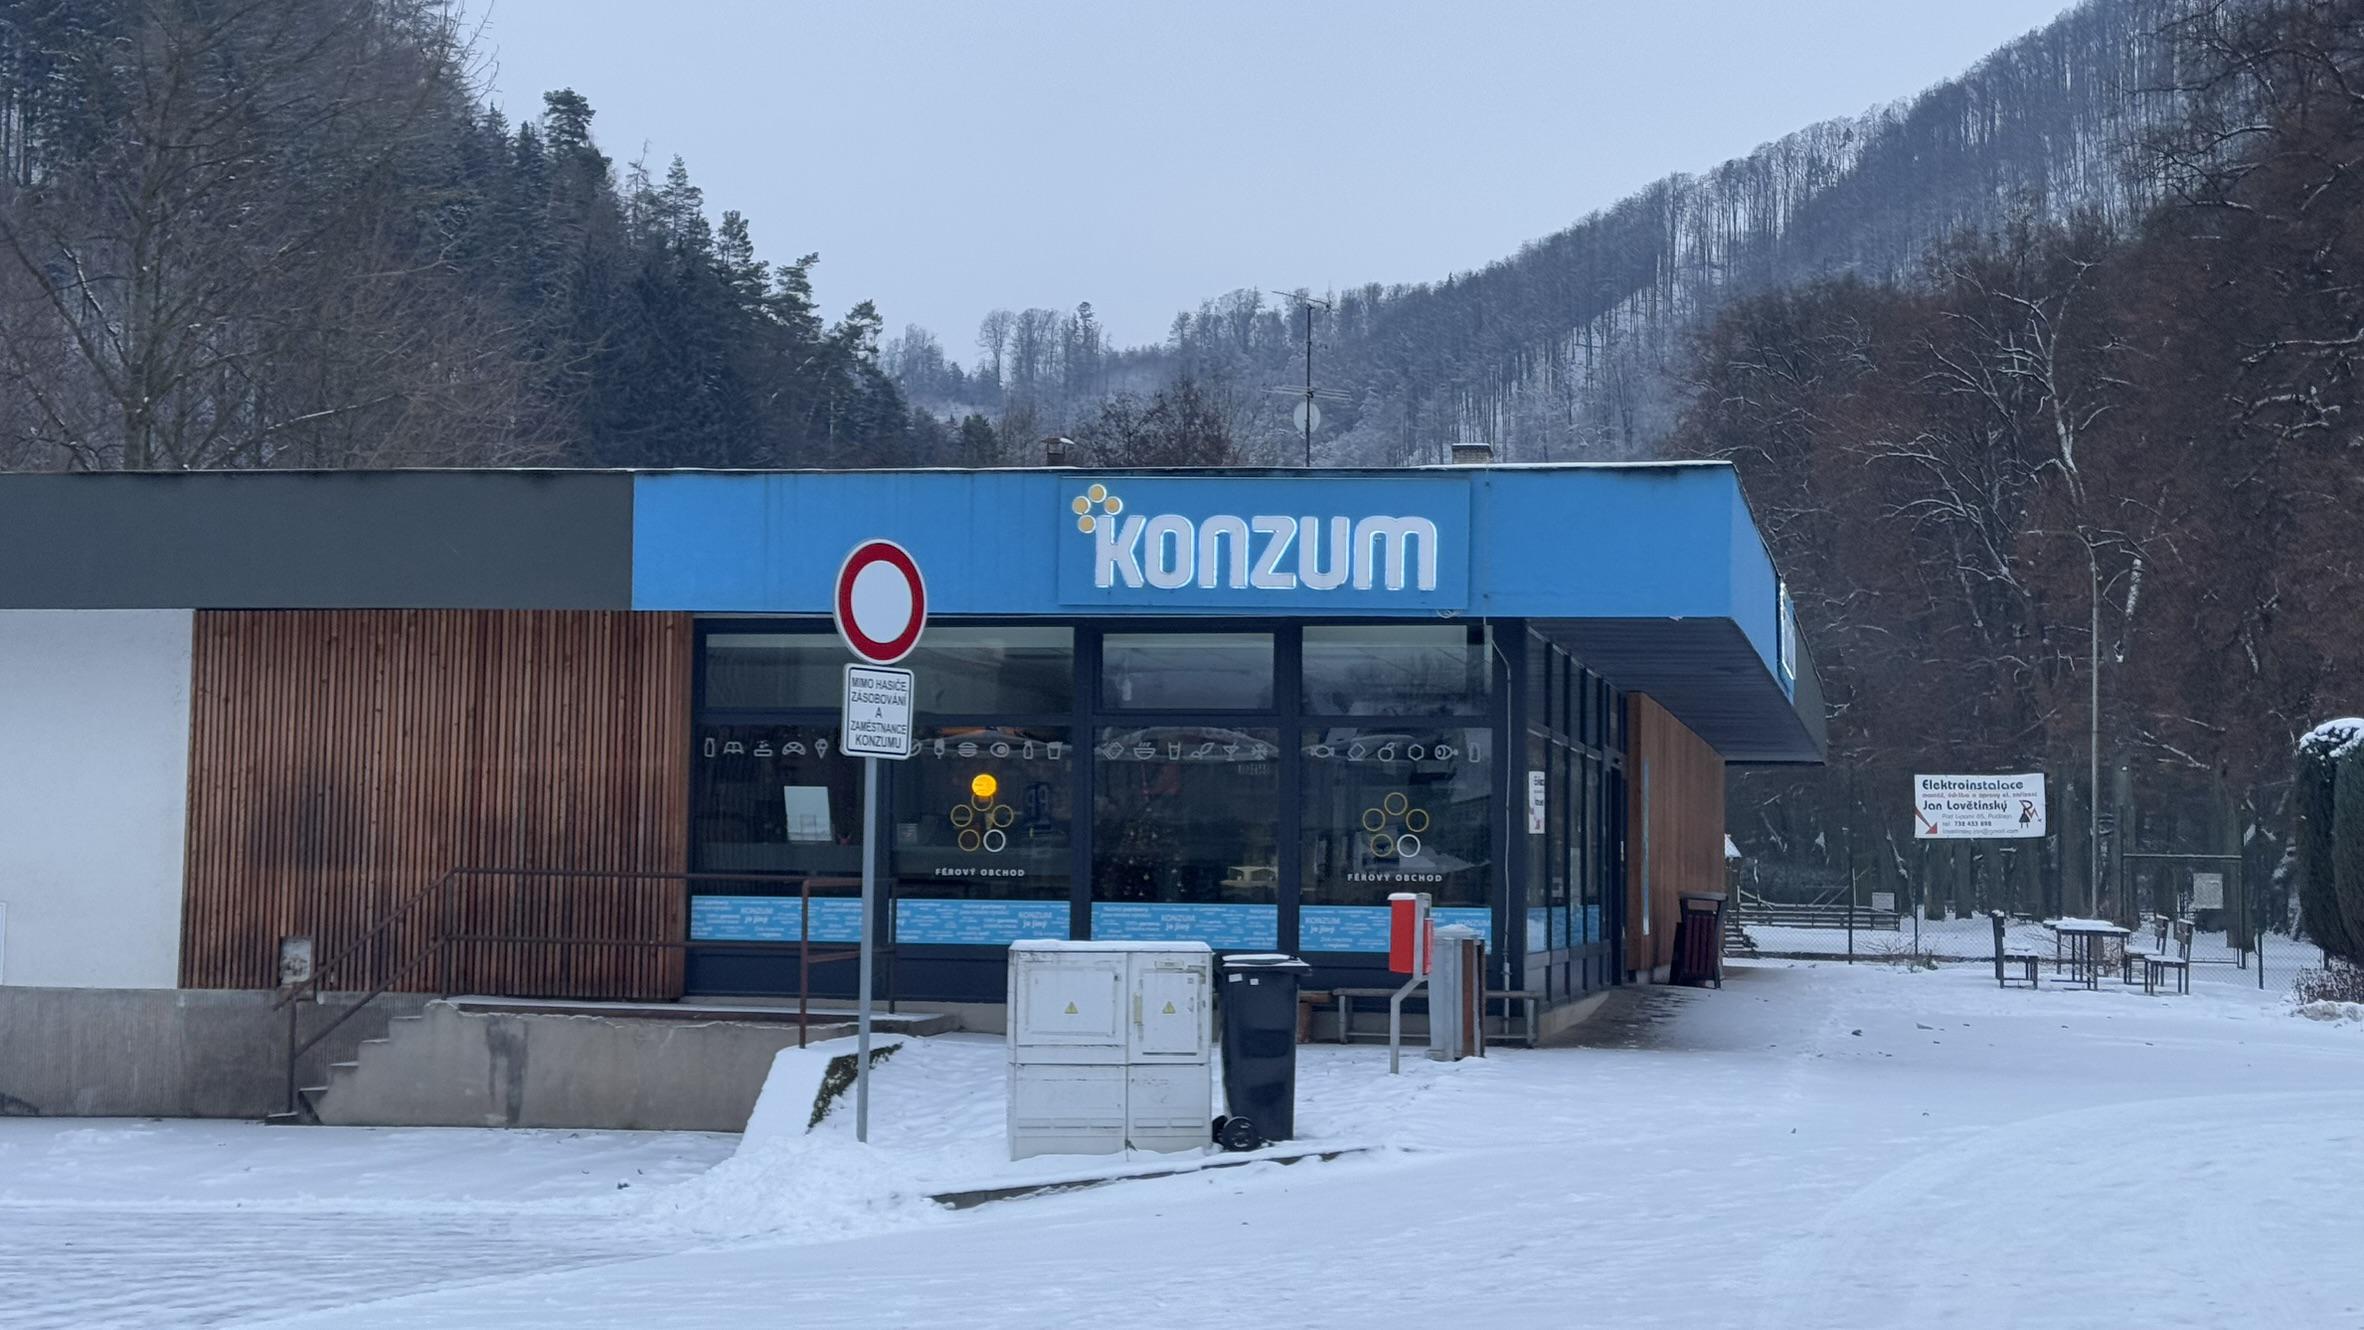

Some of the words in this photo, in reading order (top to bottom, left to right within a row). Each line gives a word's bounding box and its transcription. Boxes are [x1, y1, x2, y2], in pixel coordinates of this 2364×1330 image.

[1094, 514, 1438, 592] KONZUM
[851, 677, 874, 689] MIMO
[875, 679, 908, 692] HASIČE
[851, 690, 907, 706] ZÁSOBOVÁNÍ
[875, 706, 883, 718] A
[850, 719, 907, 735] ZAMĚSTNANCE
[855, 735, 902, 749] KONZUMU
[1922, 779, 2024, 790] Elektroinstalace
[1923, 800, 1942, 810] Jan
[935, 867, 976, 876] FÉROVÝ
[980, 868, 1025, 877] OBCHOD
[1395, 873, 1443, 882] OBCHOD
